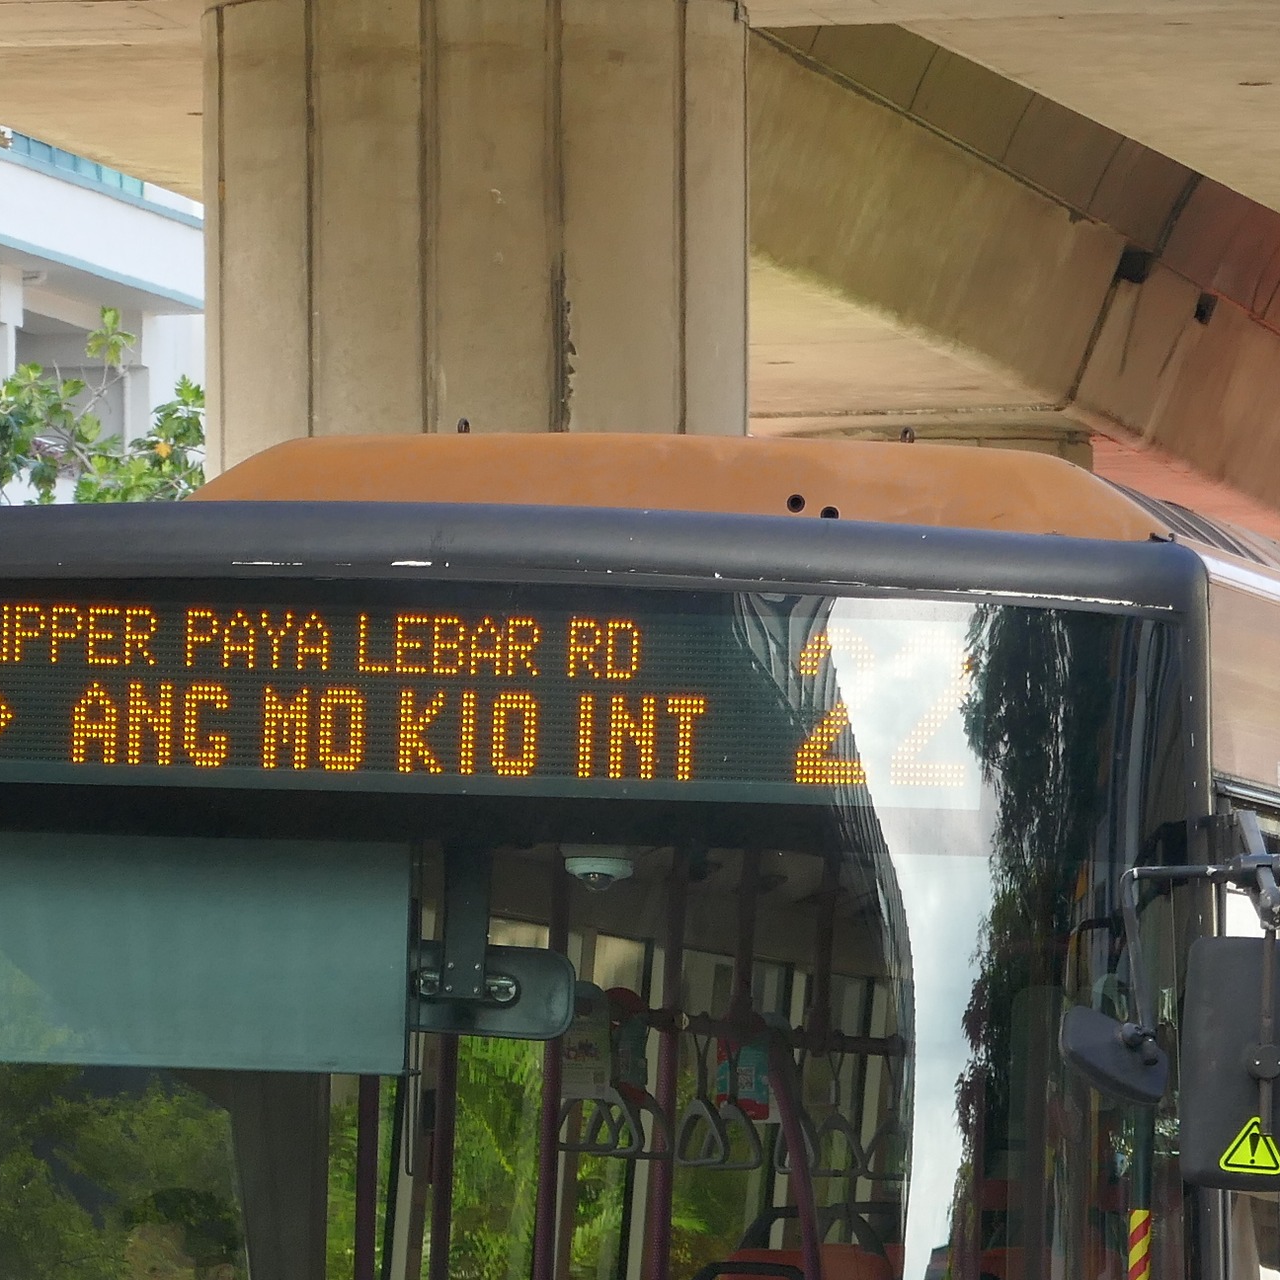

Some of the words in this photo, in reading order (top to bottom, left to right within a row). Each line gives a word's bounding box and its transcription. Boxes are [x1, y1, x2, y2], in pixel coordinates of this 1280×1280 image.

[184, 607, 329, 672] PAYA
[357, 613, 539, 677] LEBAR
[567, 620, 641, 680] RD
[70, 680, 229, 768] ANG
[261, 684, 365, 773] MO
[396, 689, 538, 776] KIO
[576, 693, 707, 782] INT
[794, 625, 974, 787] 22
